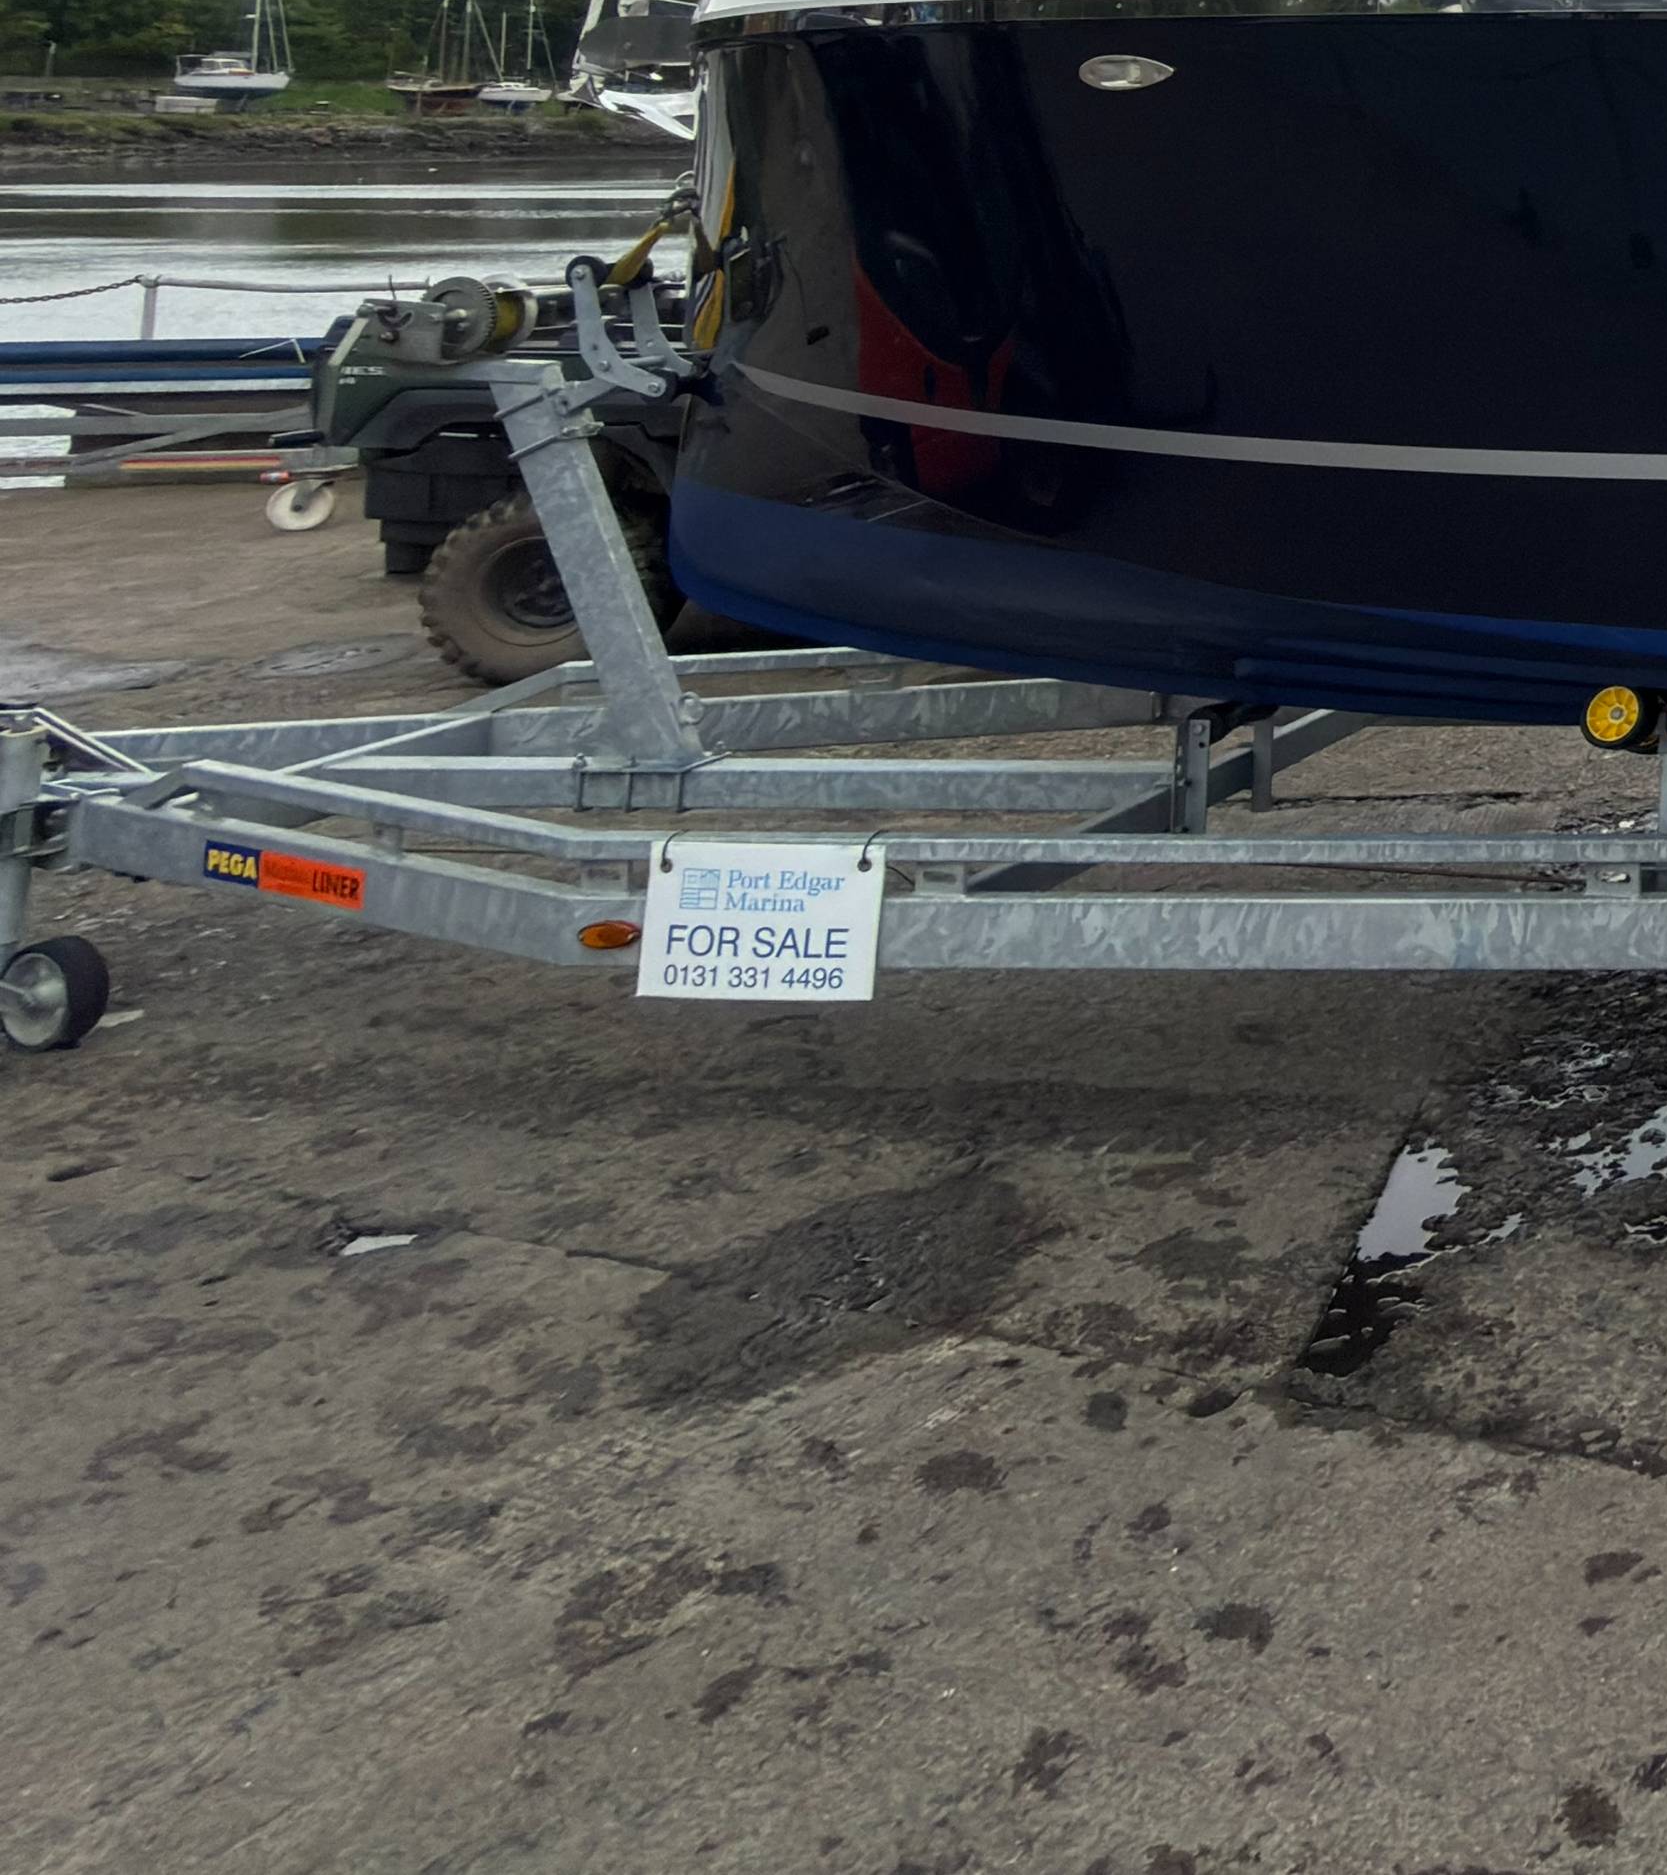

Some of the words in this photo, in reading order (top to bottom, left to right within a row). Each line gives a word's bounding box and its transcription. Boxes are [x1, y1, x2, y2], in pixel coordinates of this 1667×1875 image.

[207, 849, 257, 879] PEGA
[312, 869, 360, 900] LINER
[727, 869, 770, 889] Port
[777, 870, 845, 896] Edgar
[724, 892, 805, 912] Marina
[666, 924, 740, 957] FOR
[752, 927, 849, 958] SALE
[663, 964, 718, 987] 0131
[728, 966, 770, 988] 331
[781, 967, 843, 989] 4496
